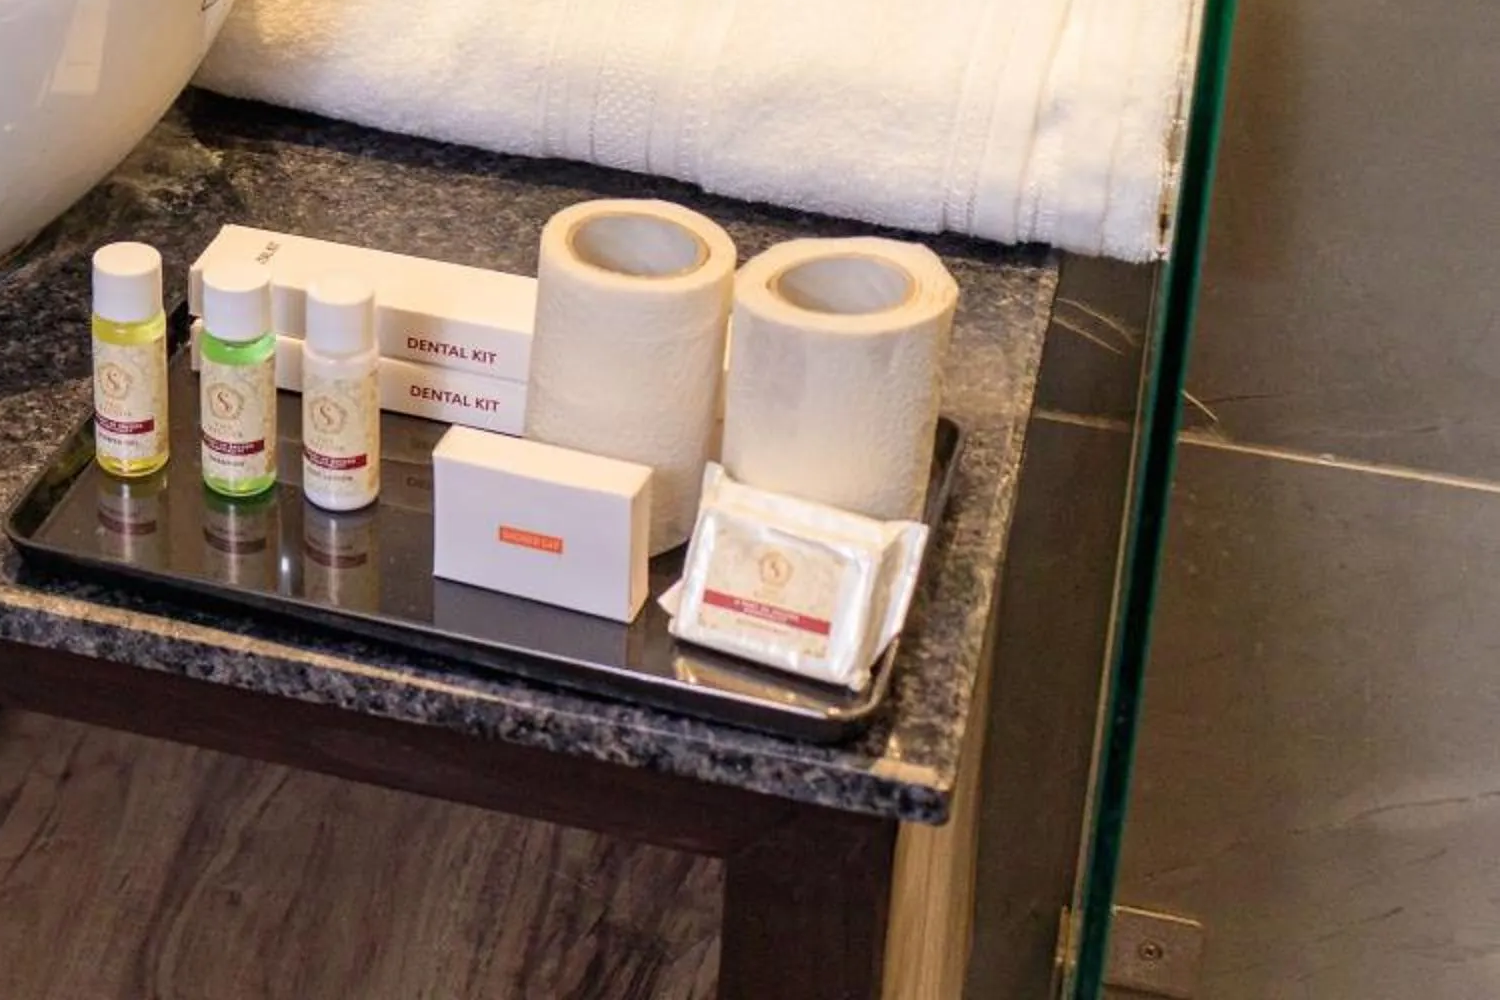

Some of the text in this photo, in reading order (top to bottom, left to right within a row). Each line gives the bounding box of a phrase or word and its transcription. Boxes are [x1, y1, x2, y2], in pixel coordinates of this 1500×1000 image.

[407, 337, 497, 364] DENTAL KIT
[410, 385, 500, 412] DENTAL KIT
